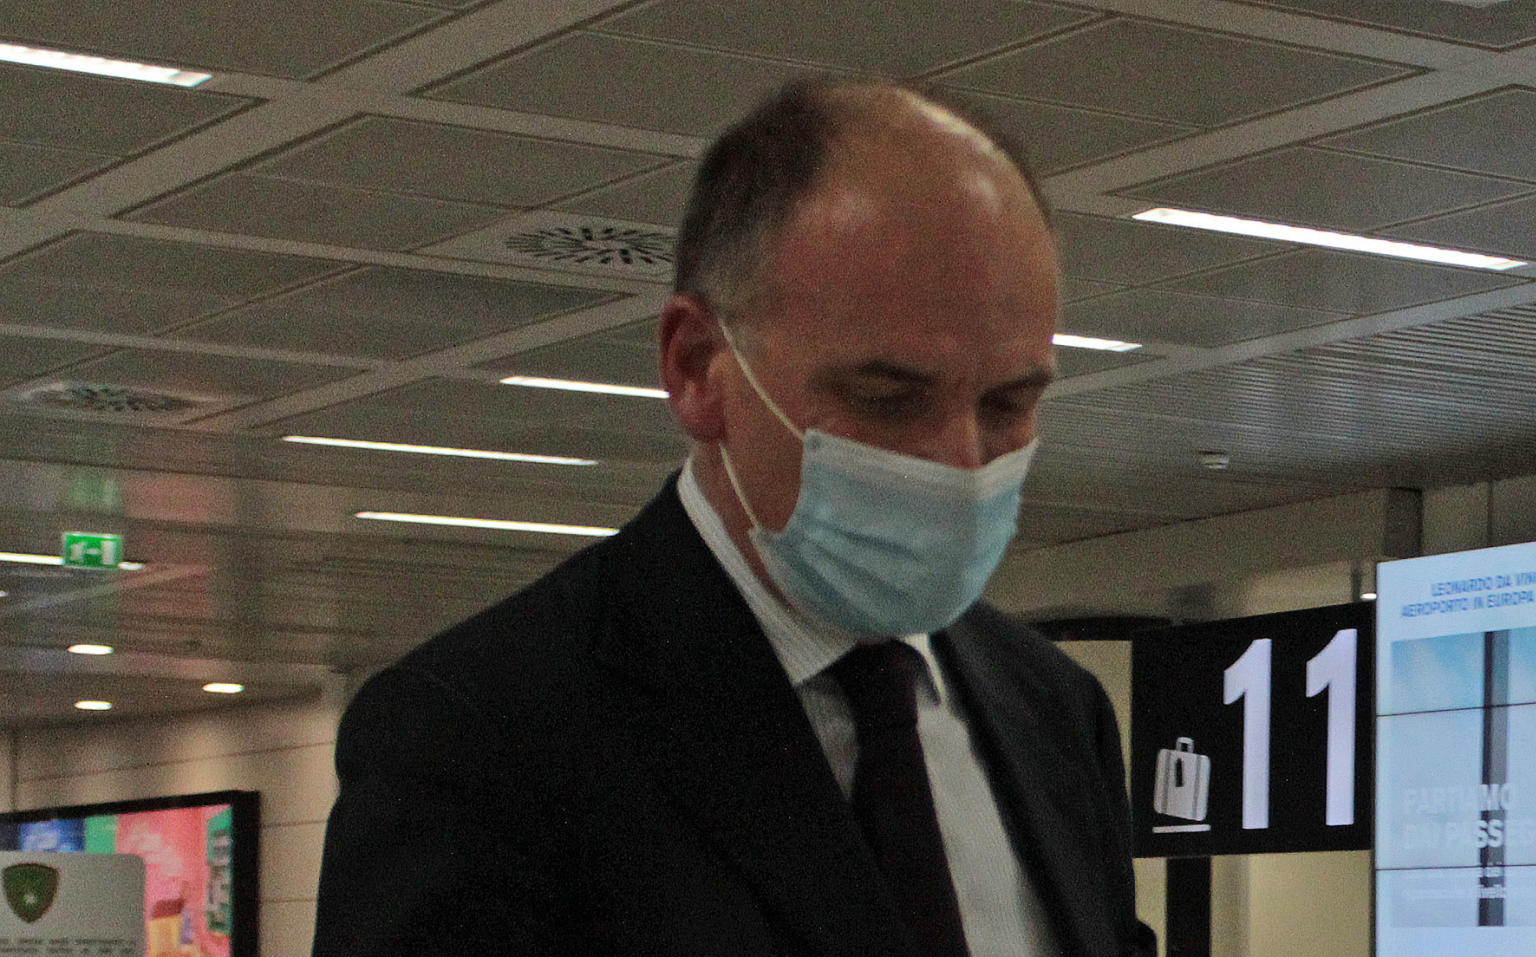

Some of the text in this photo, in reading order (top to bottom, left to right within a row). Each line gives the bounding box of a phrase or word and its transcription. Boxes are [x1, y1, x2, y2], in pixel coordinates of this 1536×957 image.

[1431, 576, 1493, 597] LEONARDO
[1495, 574, 1512, 590] DA
[1400, 597, 1469, 618] AEROPORTO
[1473, 596, 1485, 610] IN
[1486, 590, 1535, 609] EUROPA
[1223, 628, 1358, 830] 11
